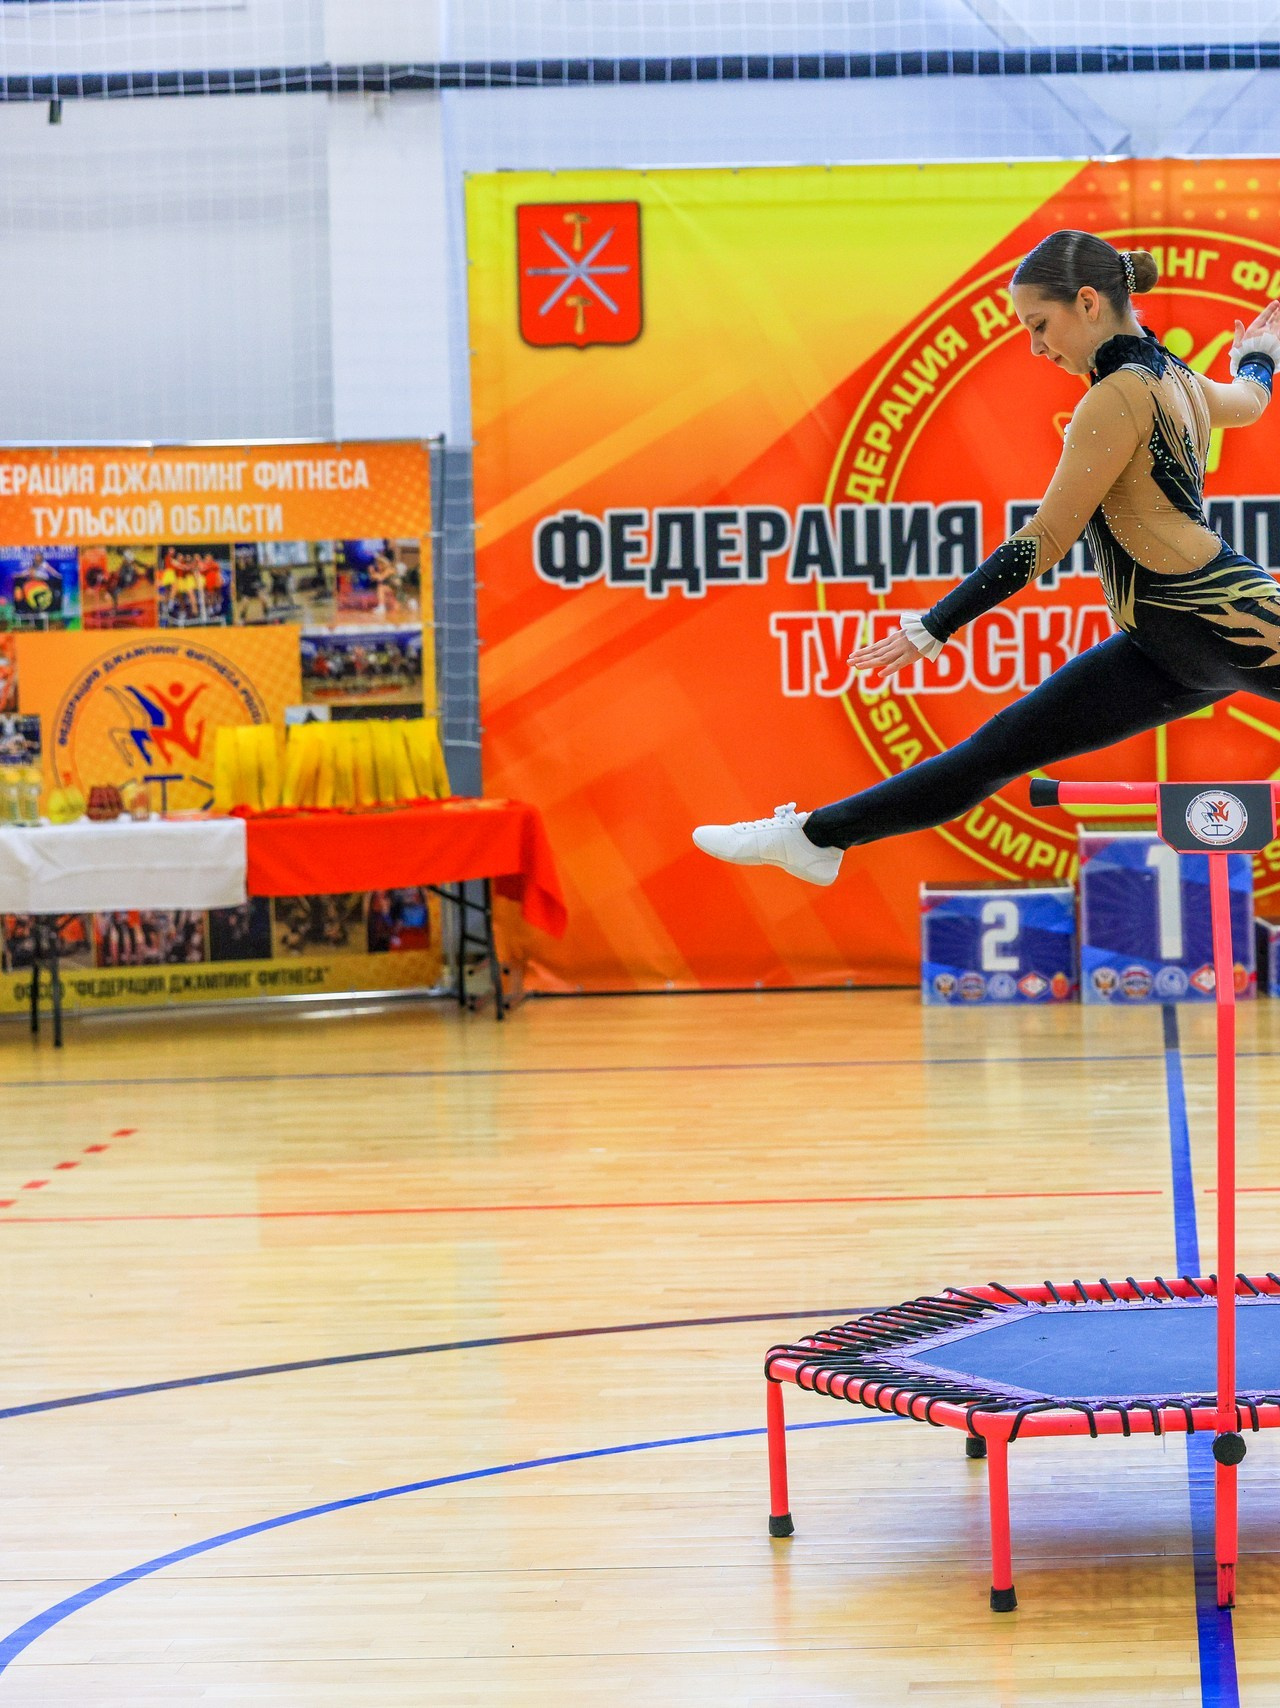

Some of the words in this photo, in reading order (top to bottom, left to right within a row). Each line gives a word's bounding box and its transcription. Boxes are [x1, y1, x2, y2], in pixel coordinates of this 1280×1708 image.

[845, 325, 969, 504] ДЕРАЦИЯ
[101, 460, 248, 497] ДЖАМПИНГ
[254, 458, 369, 492] ФИТНЕСА
[32, 500, 164, 538] ТУЛЬСКОЙ
[170, 503, 284, 535] ОБЛАСТИ
[536, 502, 981, 598] ФЕДЕРАЦИЯ
[963, 805, 1079, 881] UMPI
[980, 900, 1020, 971] 2
[1146, 844, 1183, 960] 1
